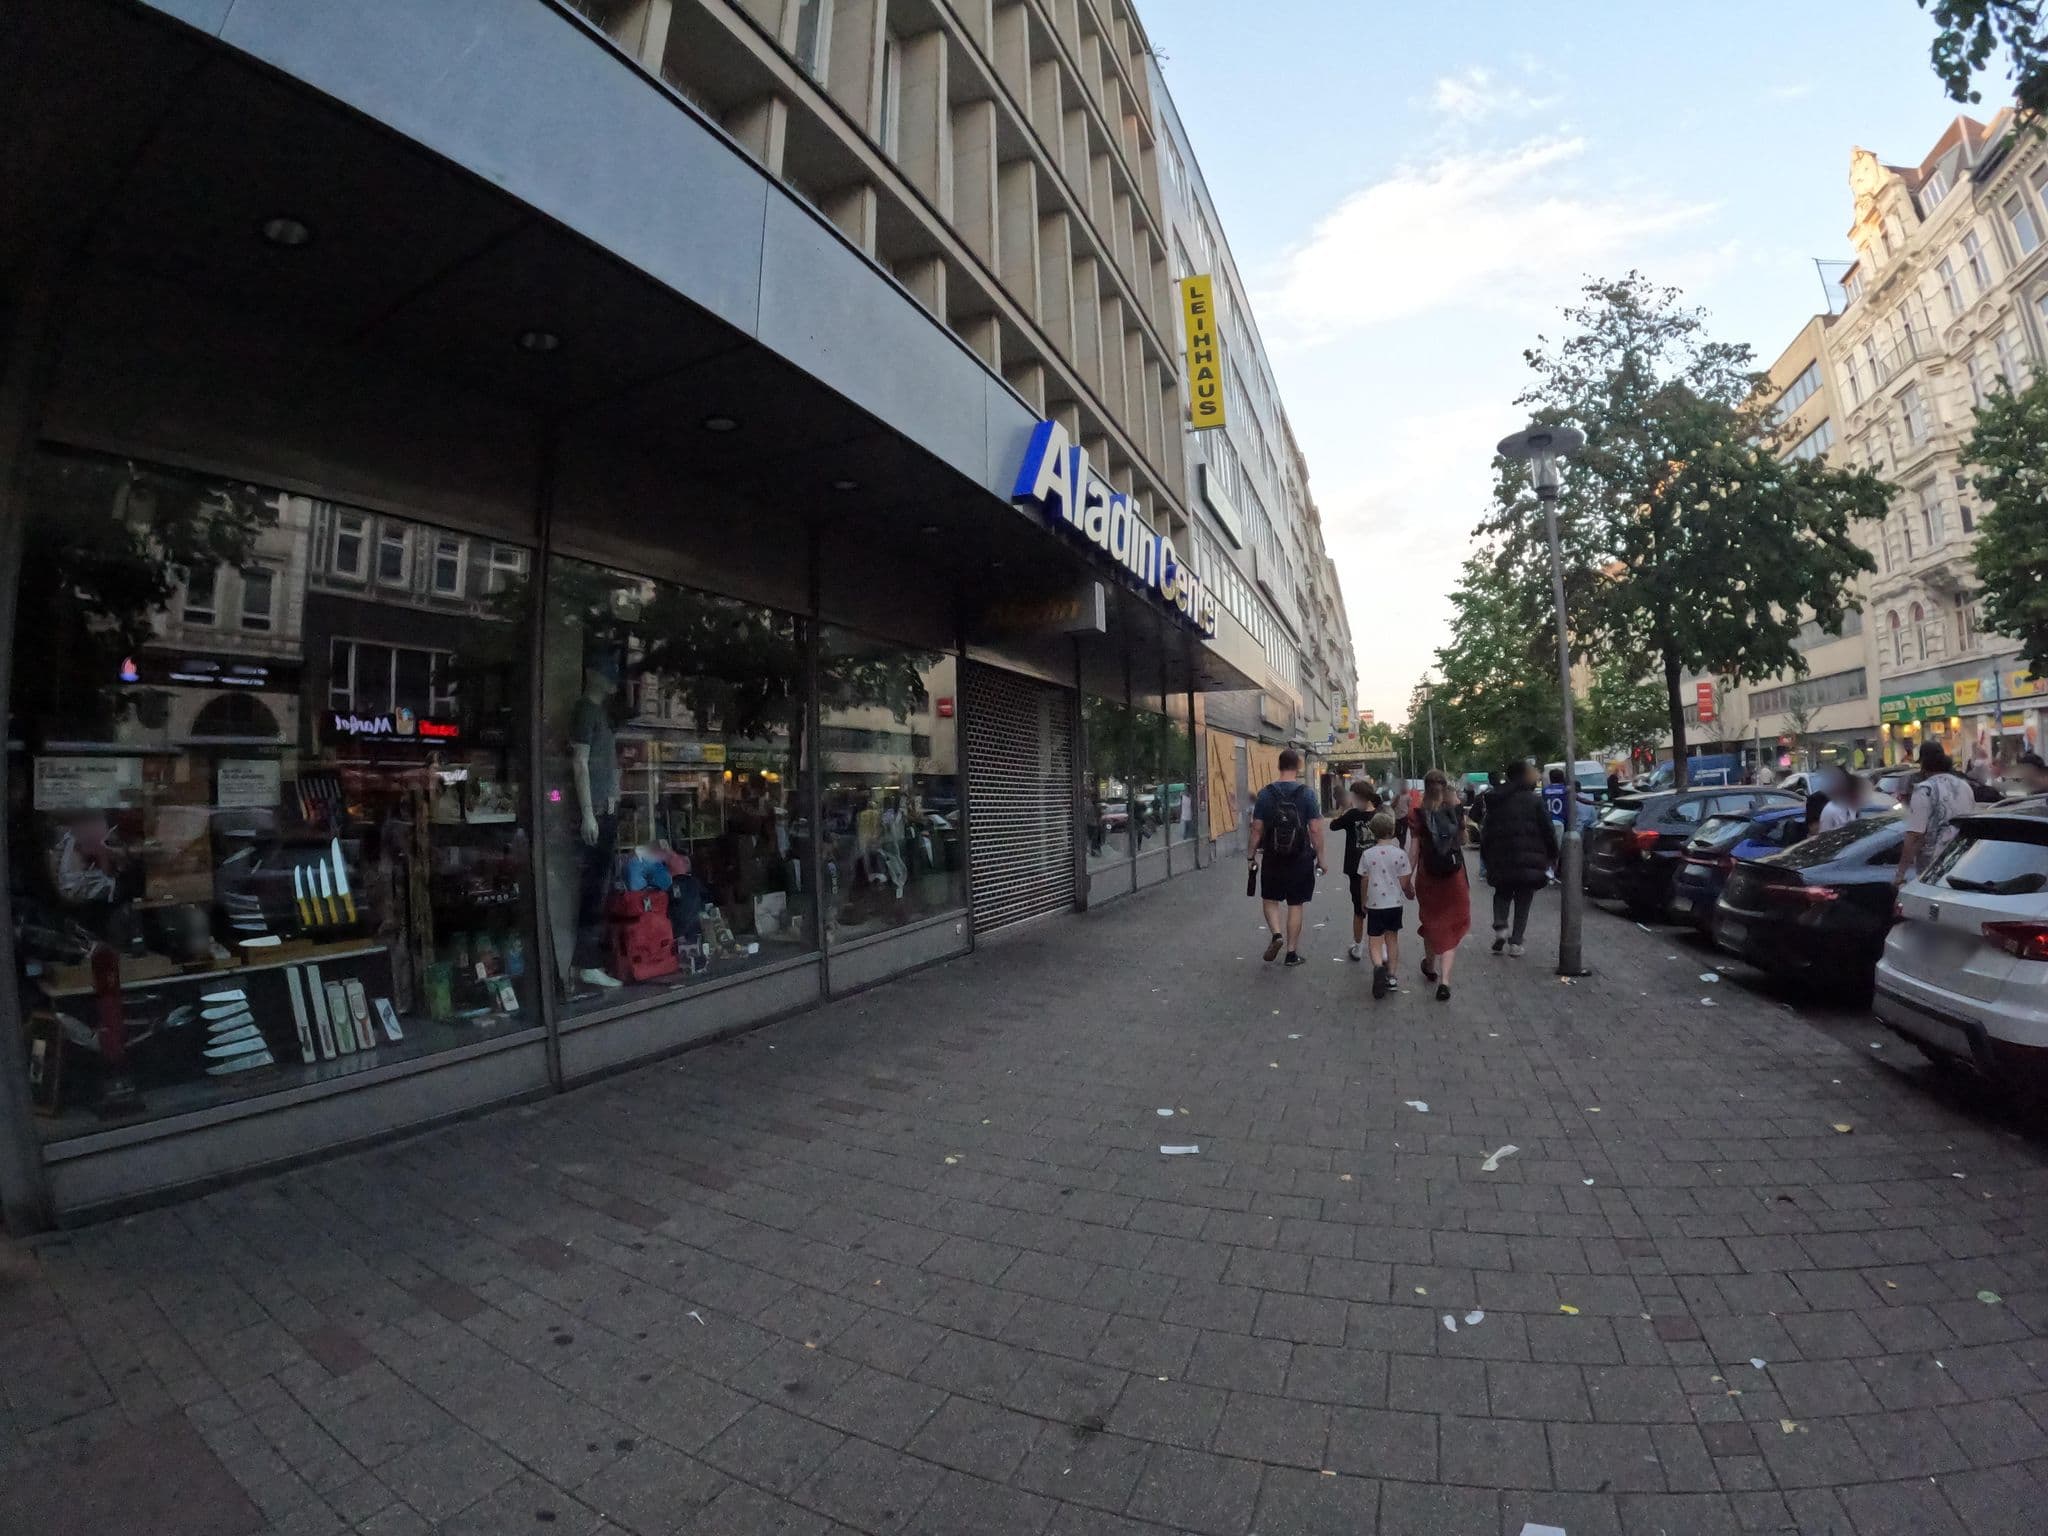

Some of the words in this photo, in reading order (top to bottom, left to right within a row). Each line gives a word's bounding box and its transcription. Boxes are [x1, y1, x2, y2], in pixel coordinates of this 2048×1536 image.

[1190, 286, 1217, 415] LEIHHAUS
[1031, 420, 1157, 588] Aladin
[1159, 535, 1219, 640] Center
[1546, 798, 1563, 815] 10
